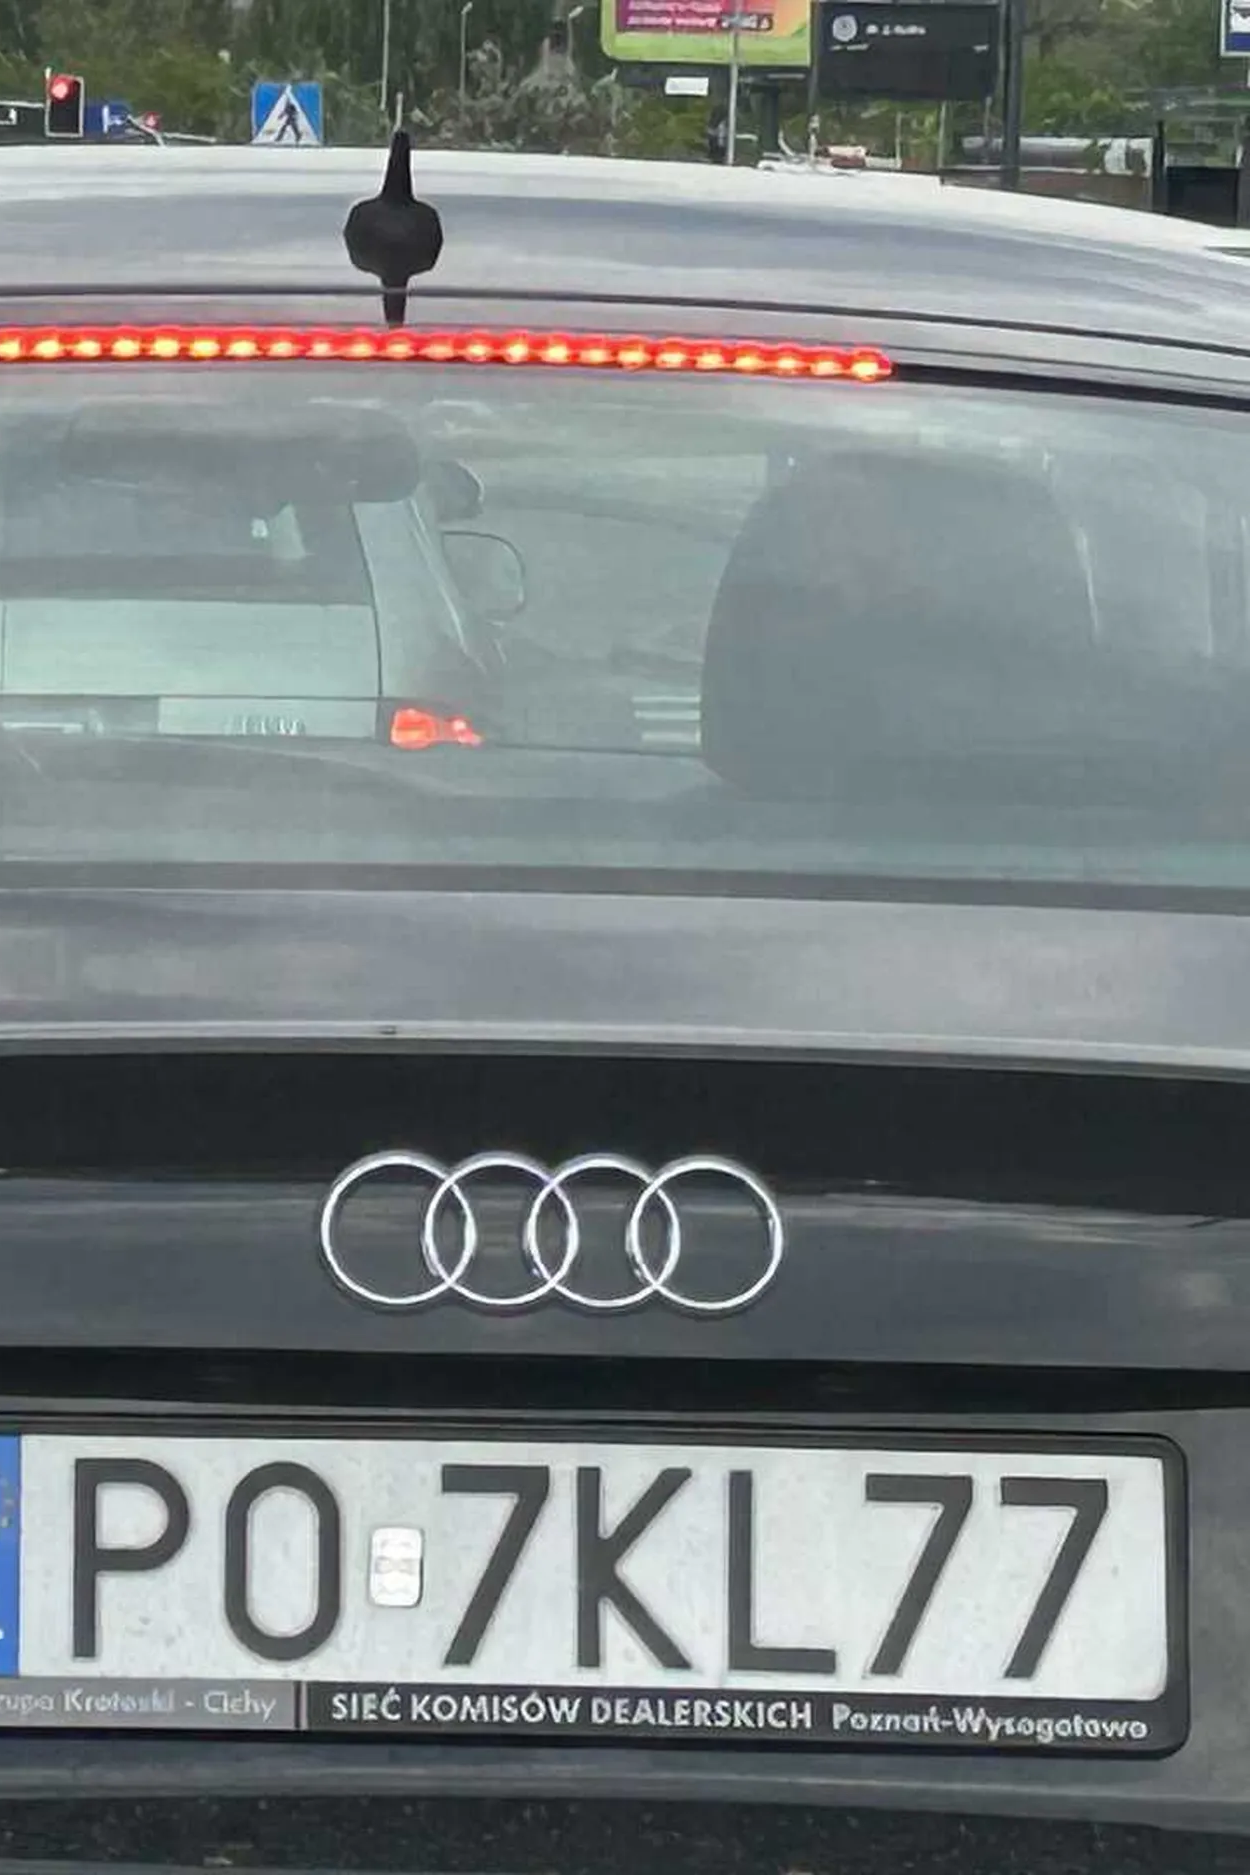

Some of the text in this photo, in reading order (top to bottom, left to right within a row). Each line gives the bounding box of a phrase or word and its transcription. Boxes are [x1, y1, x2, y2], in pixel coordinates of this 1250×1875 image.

[72, 1456, 1109, 1680] PO 7KL77
[331, 1687, 1149, 1742] SIEĆ KOMISÓW DEALERSKICH Poznań-Wysogotowo
